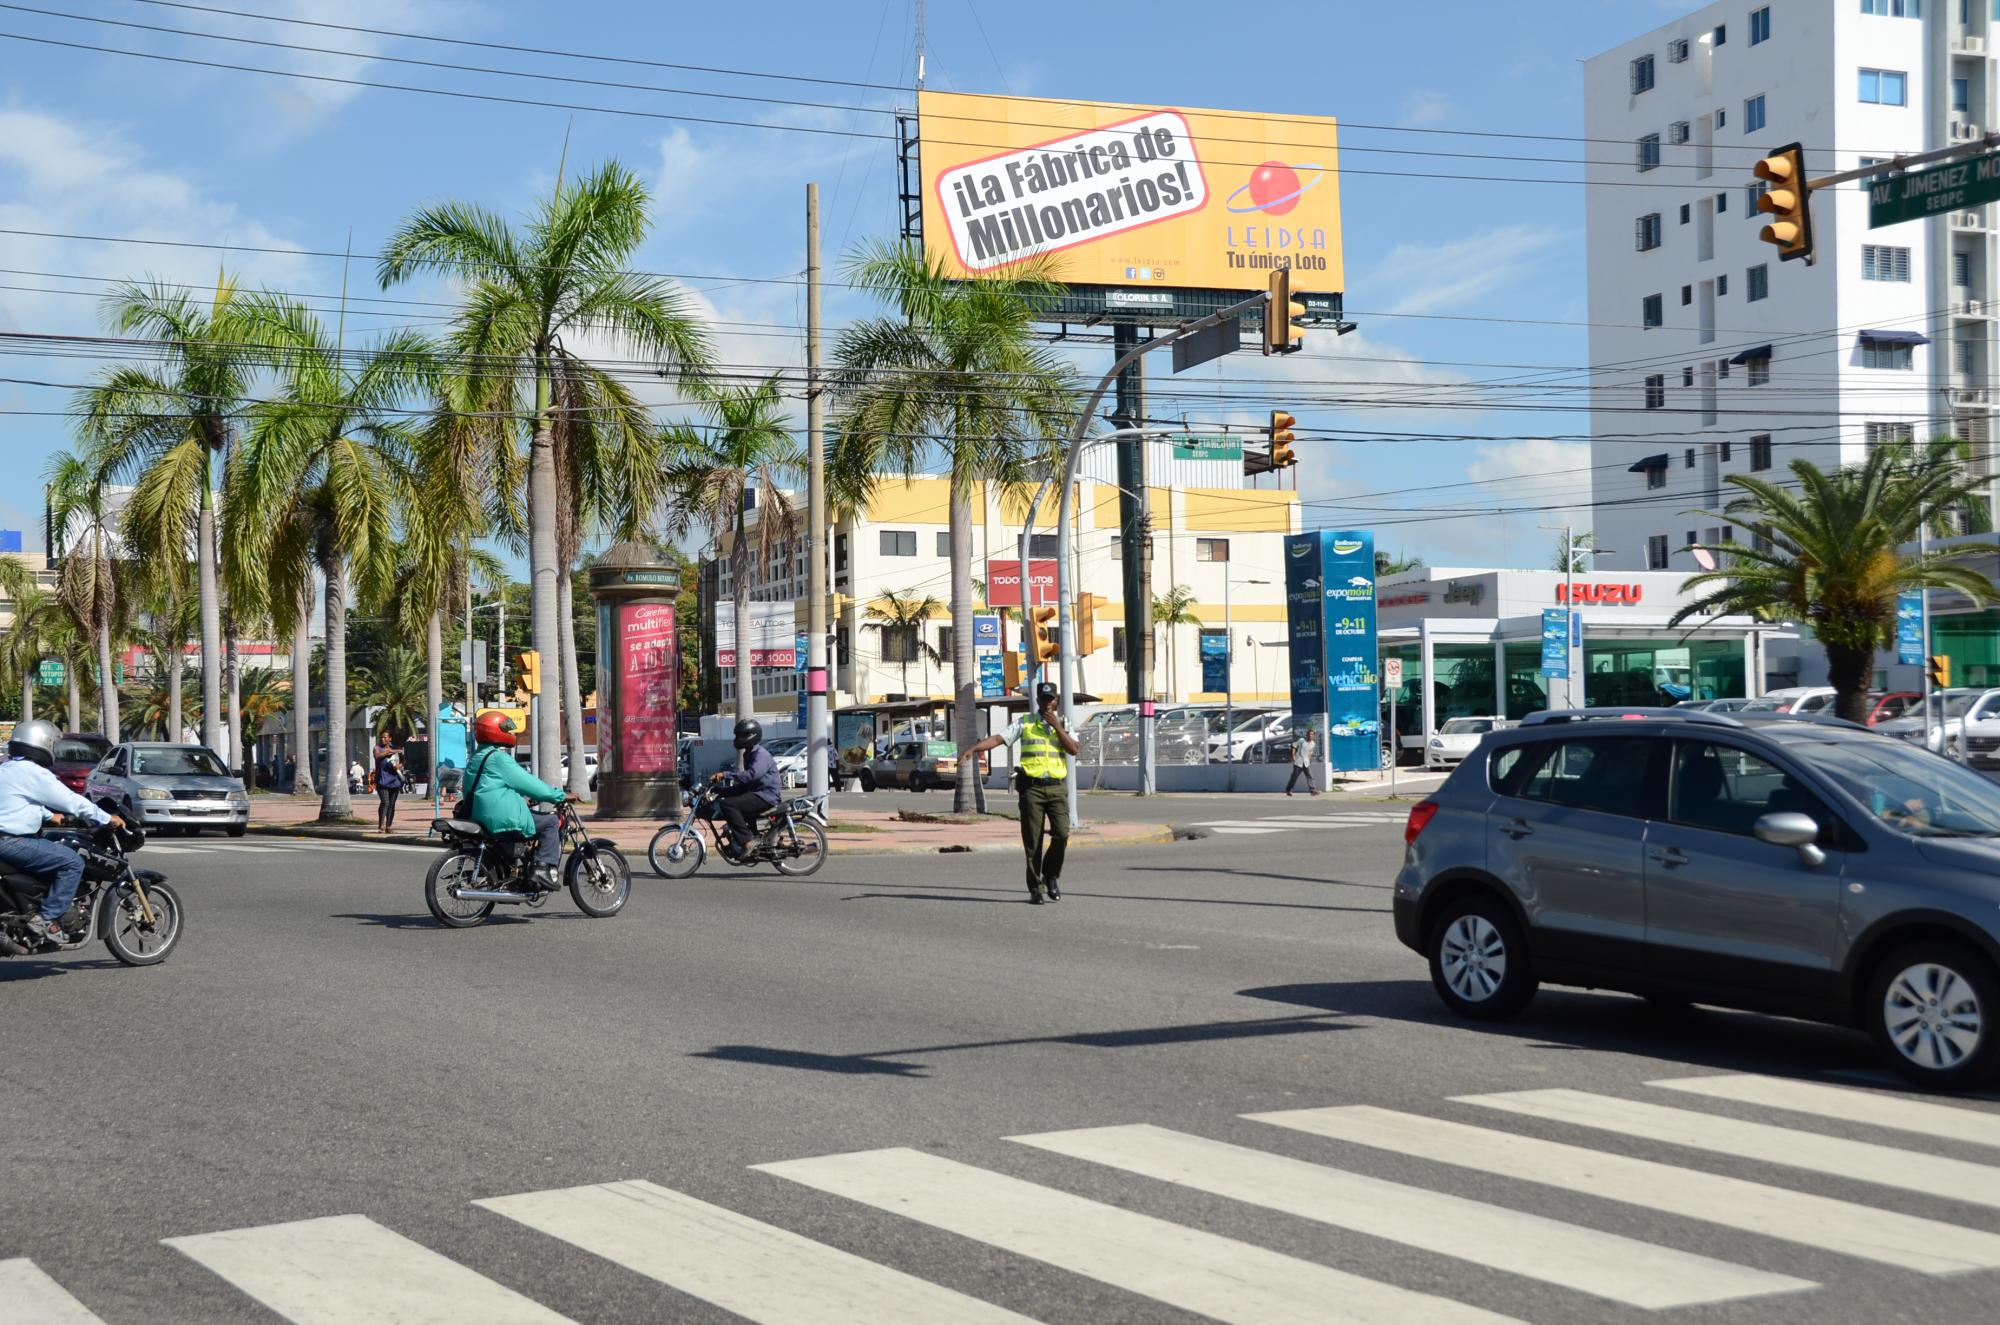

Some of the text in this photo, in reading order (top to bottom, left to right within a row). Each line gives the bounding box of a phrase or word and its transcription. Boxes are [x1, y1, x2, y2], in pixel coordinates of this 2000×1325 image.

[953, 126, 1176, 217] ¡La Fábrica de
[1871, 186, 1892, 206] AV.
[1901, 165, 1968, 200] JIMENEZ
[966, 160, 1194, 261] Millonarios!
[1926, 190, 1963, 211] SEOPC
[1227, 226, 1325, 250] LEIDSA
[1226, 250, 1327, 270] Tu única Loto
[1557, 583, 1642, 604] ISUZU
[1342, 617, 1350, 630] 9
[1355, 617, 1366, 629] 11
[630, 642, 641, 652] se
[630, 653, 639, 672] A
[768, 653, 792, 662] 1000
[1328, 670, 1378, 686] vehículo
